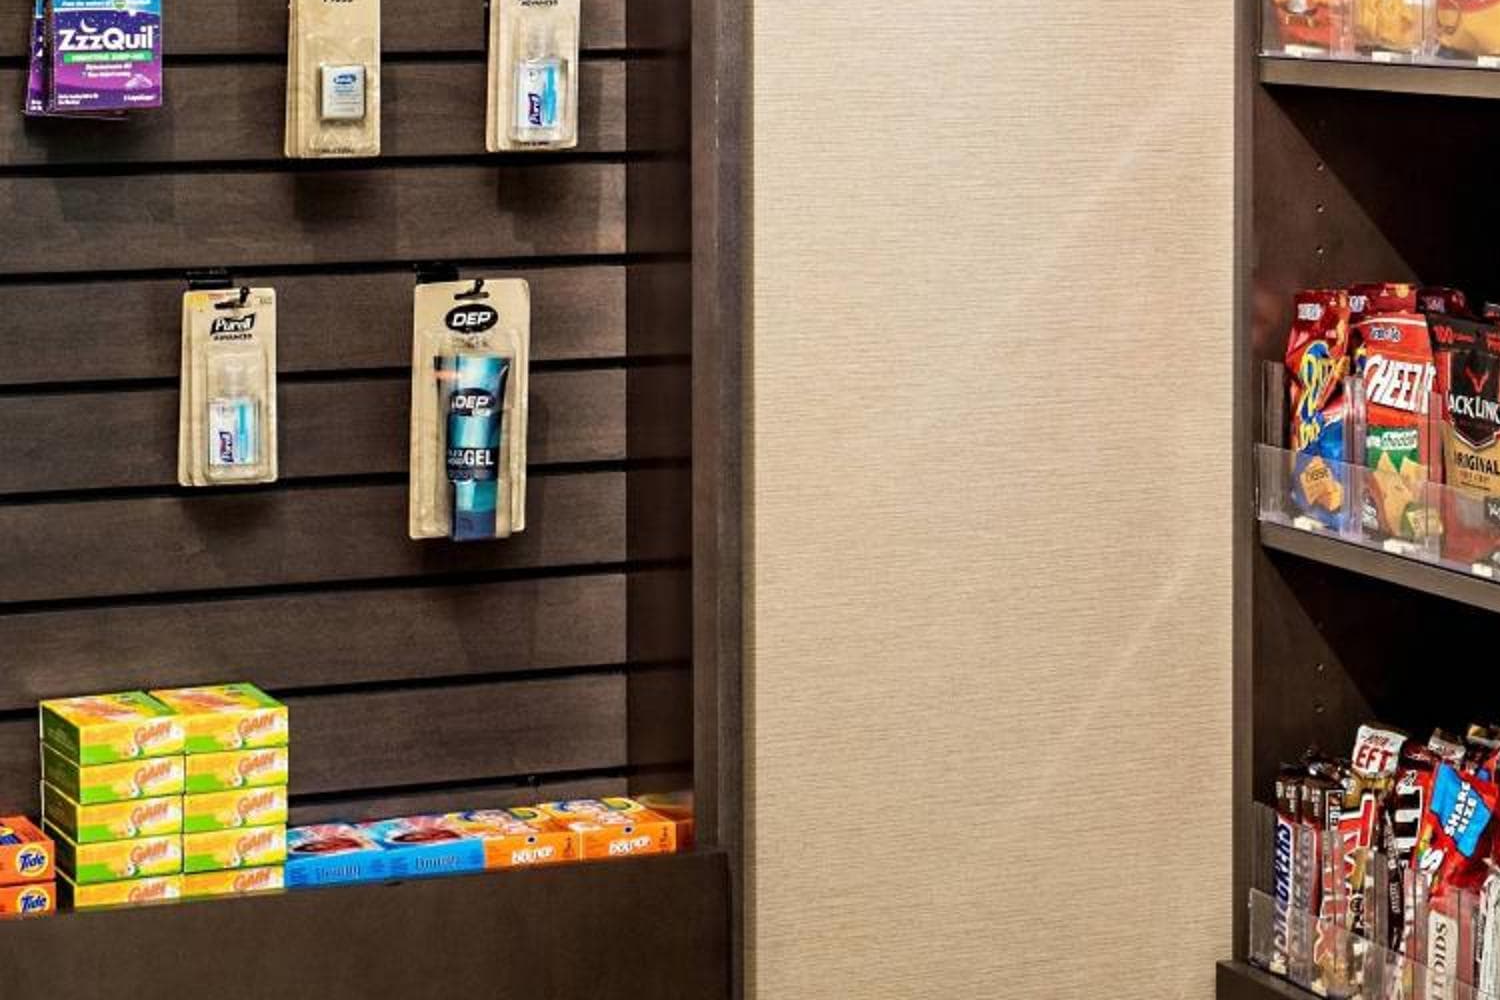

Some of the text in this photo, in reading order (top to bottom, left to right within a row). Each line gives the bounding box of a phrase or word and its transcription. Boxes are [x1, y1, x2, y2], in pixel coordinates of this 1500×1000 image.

[58, 25, 154, 52] ZzzQuil
[452, 311, 491, 327] DEP
[455, 395, 489, 410] DEP
[1448, 394, 1475, 419] ACK
[464, 449, 494, 467] GEL
[1356, 743, 1393, 772] EFT
[1445, 782, 1471, 838] SHARE
[19, 852, 45, 871] Tide
[20, 893, 47, 912] Tide
[1431, 921, 1447, 1000] TOIDS
